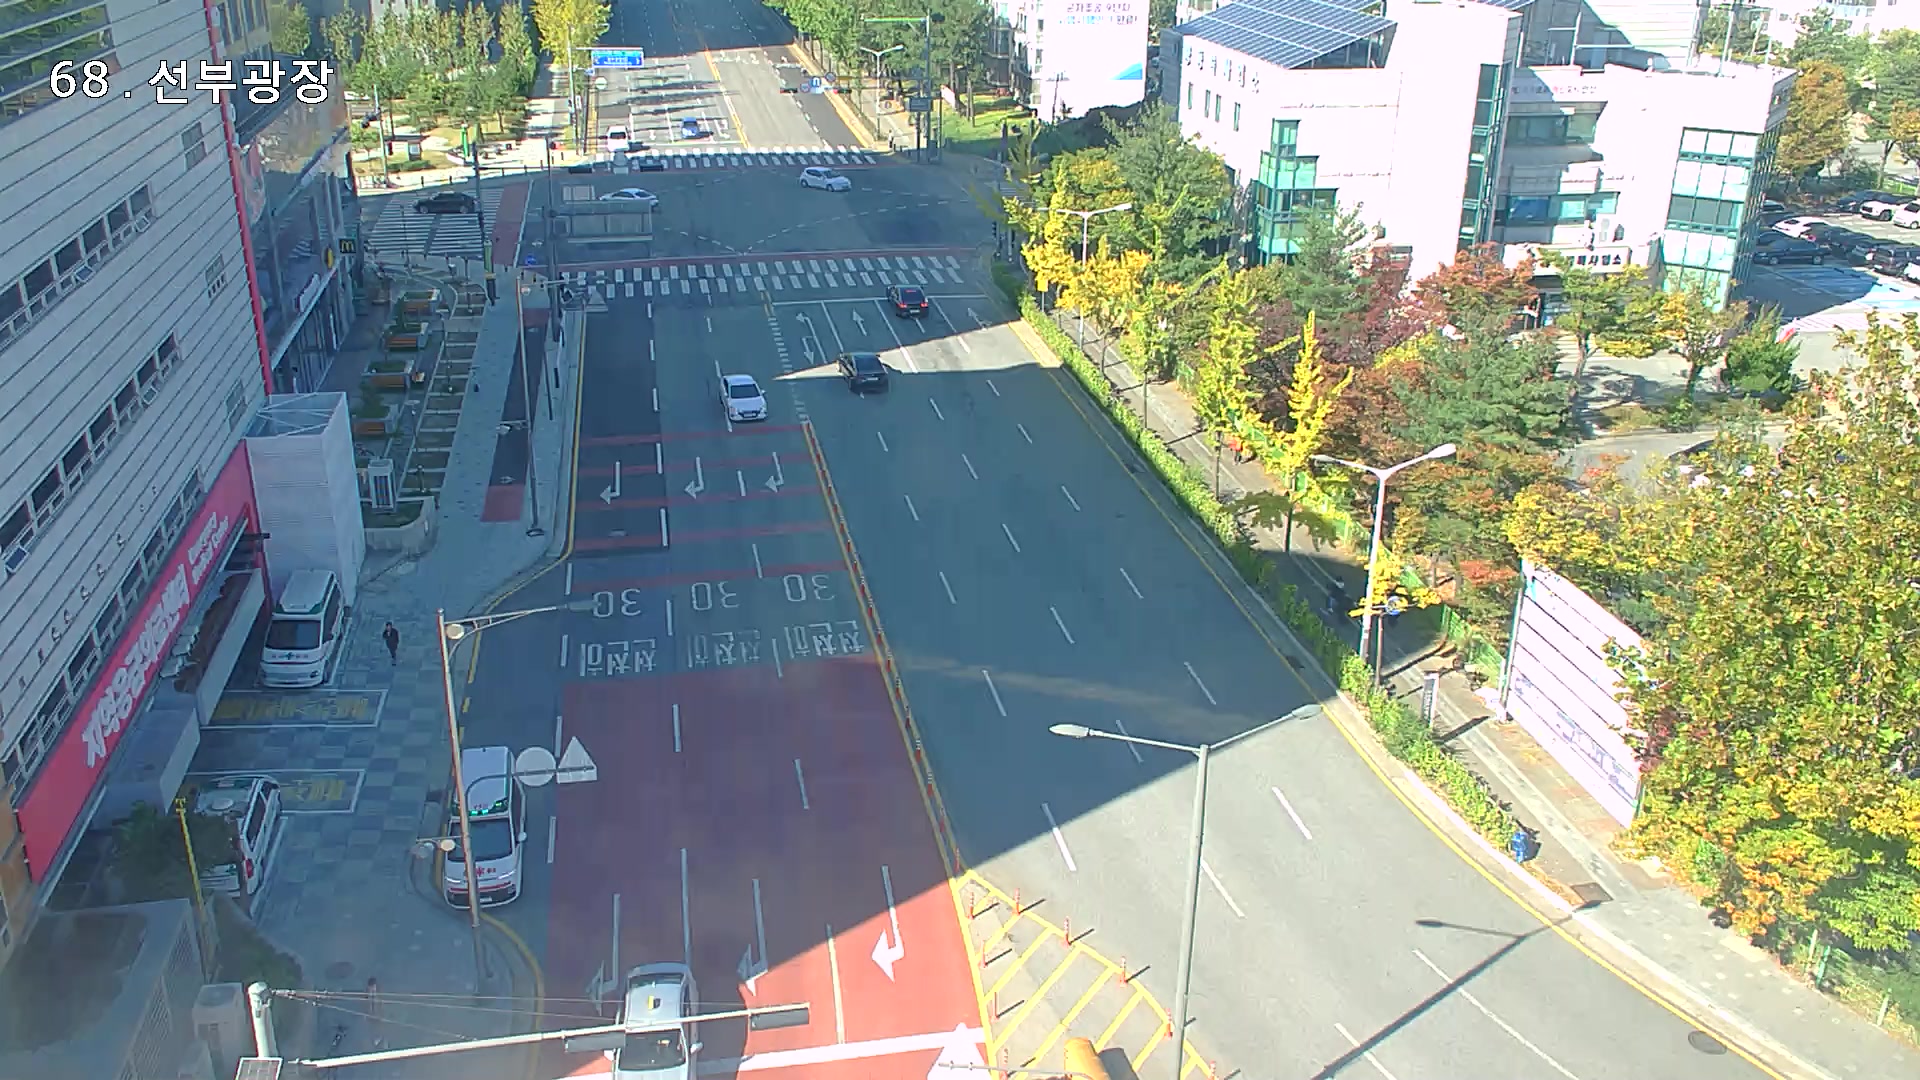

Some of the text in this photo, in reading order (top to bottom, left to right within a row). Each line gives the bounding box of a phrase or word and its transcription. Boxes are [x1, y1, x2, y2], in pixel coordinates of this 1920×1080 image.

[592, 588, 642, 618] 30
[691, 580, 740, 611] 30
[783, 574, 836, 602] 30
[784, 620, 865, 660] 천천히
[579, 638, 657, 677] 천천히
